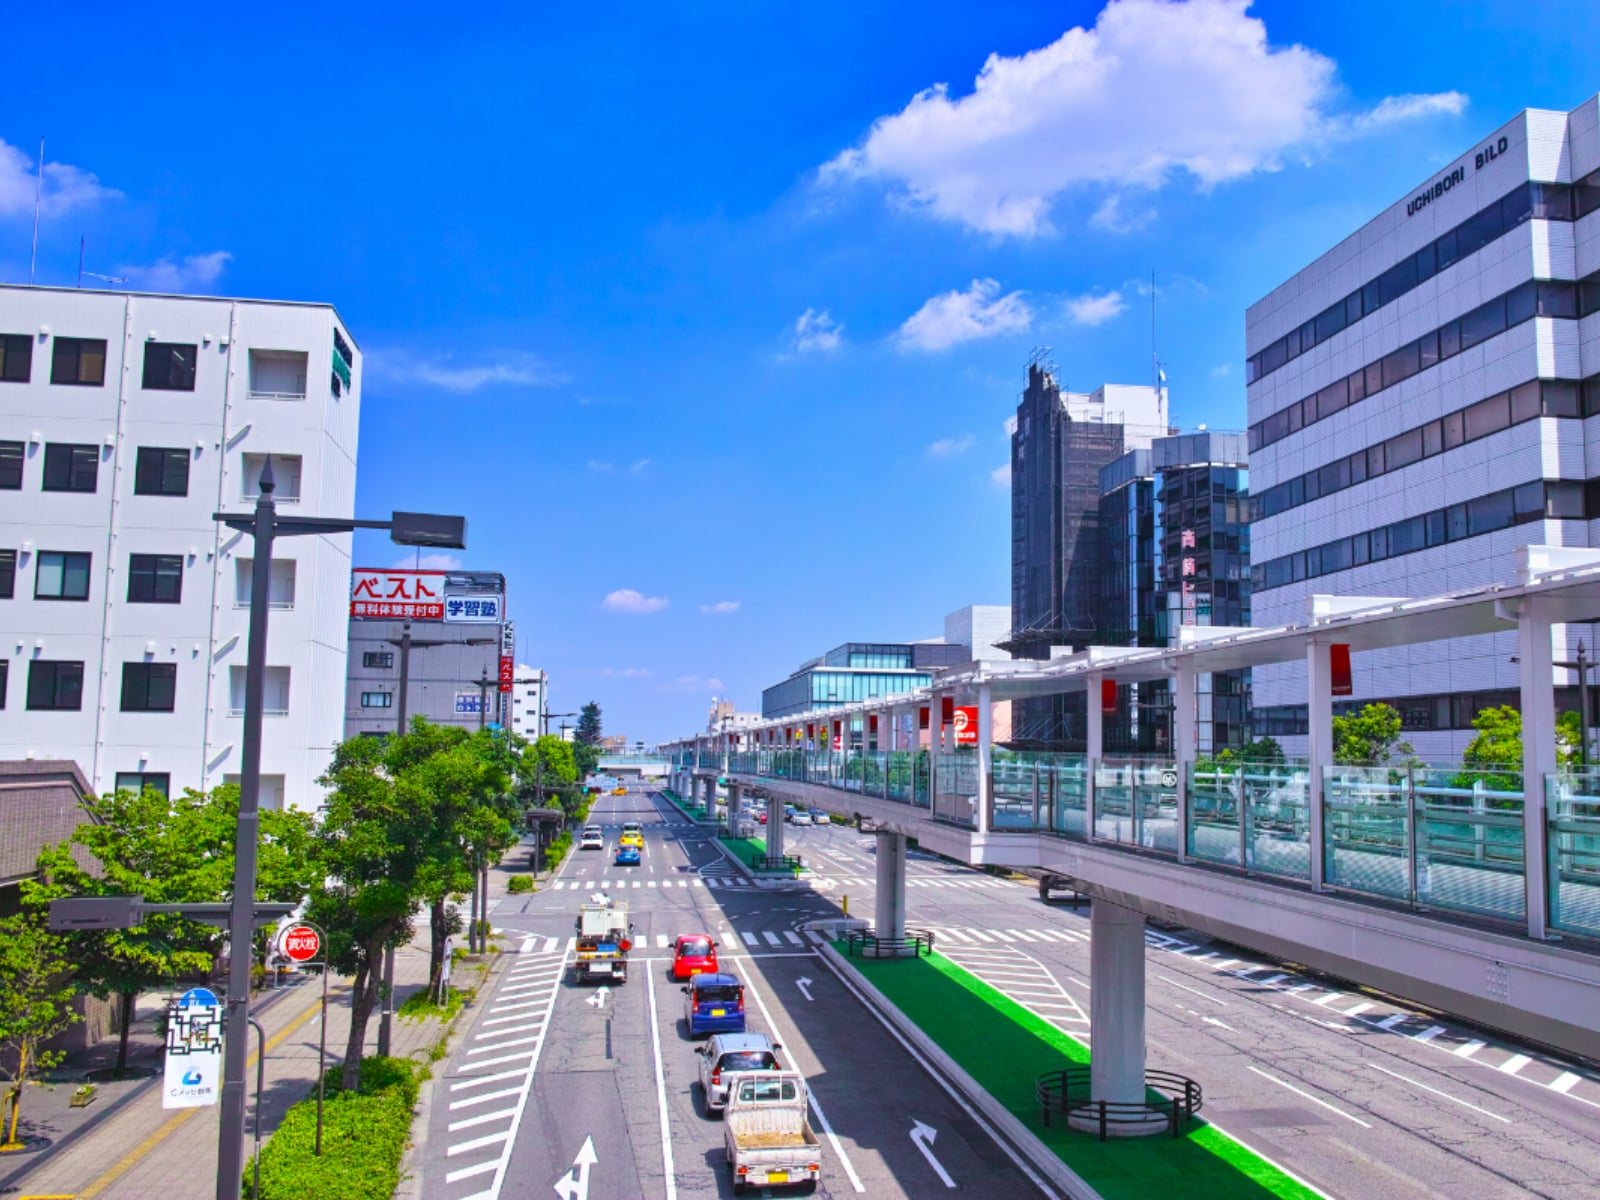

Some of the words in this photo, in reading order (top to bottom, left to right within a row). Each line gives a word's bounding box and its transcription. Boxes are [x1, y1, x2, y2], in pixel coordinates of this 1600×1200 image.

[1407, 166, 1464, 217] UCHIBORI
[1475, 136, 1508, 170] BILD
[353, 577, 436, 600] ベスト
[354, 603, 440, 617] 無料体験受付中
[447, 600, 497, 617] 学習塾
[287, 937, 317, 951] 消火栓
